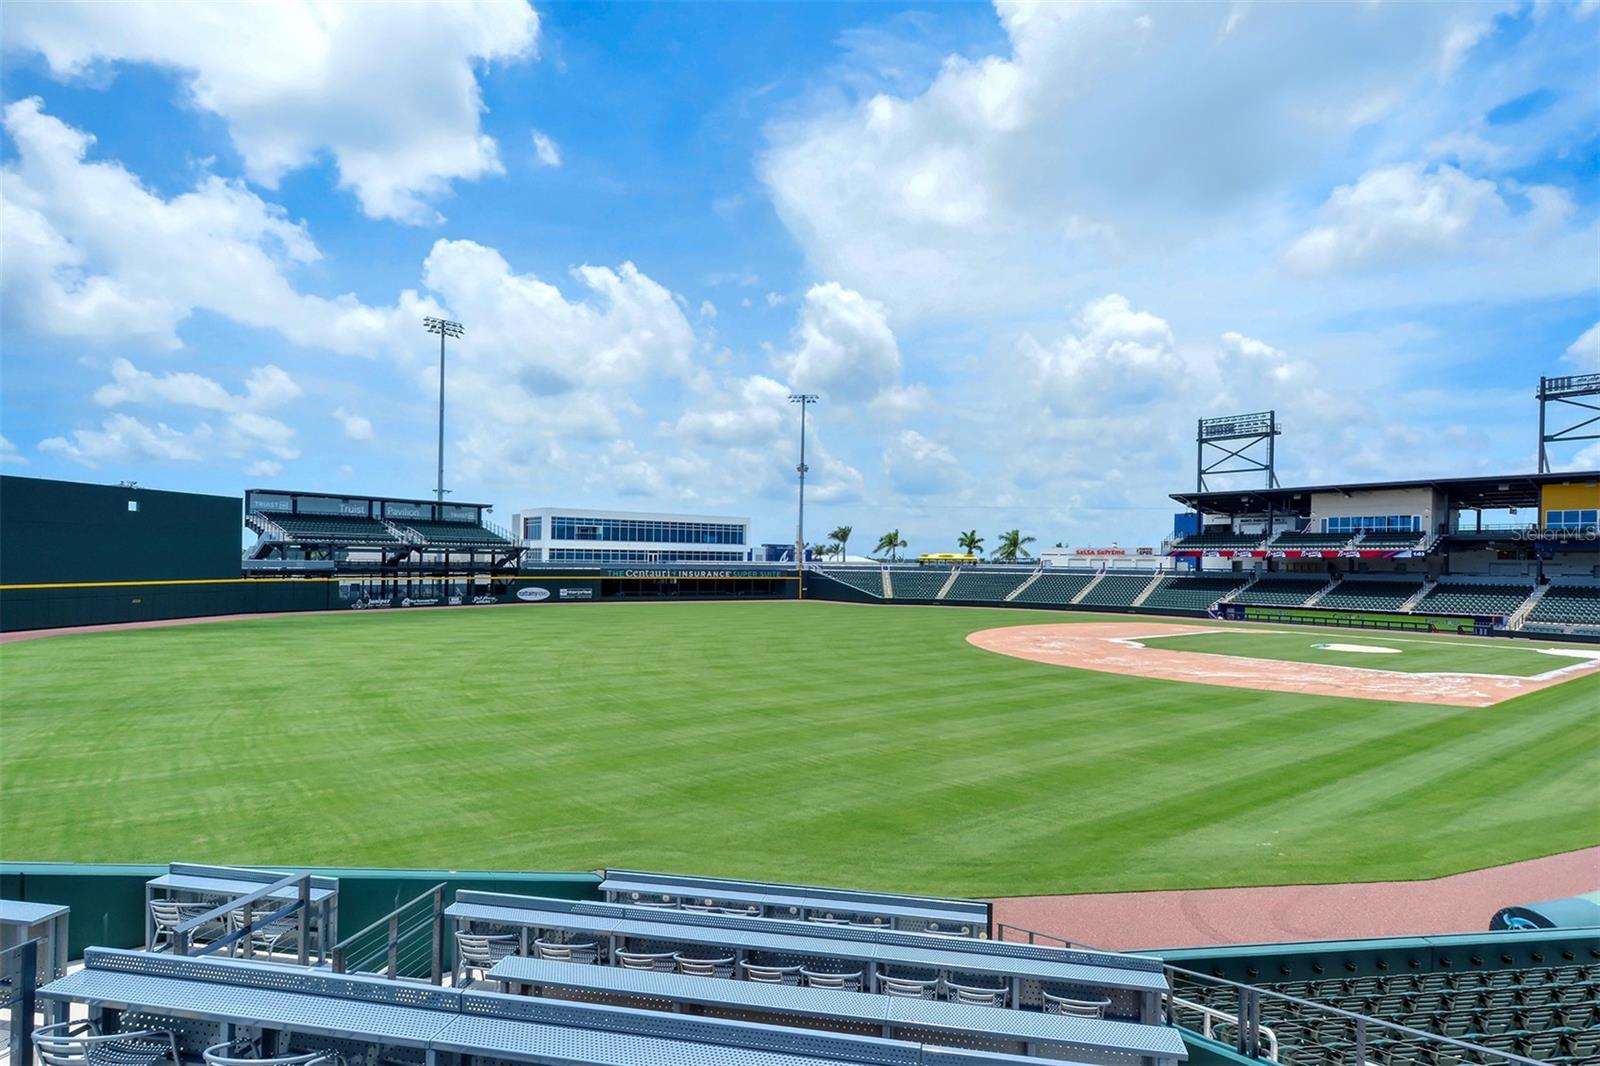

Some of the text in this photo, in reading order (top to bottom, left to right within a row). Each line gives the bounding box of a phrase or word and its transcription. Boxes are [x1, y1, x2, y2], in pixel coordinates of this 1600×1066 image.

[340, 503, 420, 517] Truist Pavilion
[625, 569, 671, 577] Centauri
[678, 570, 730, 578] INSURANCE
